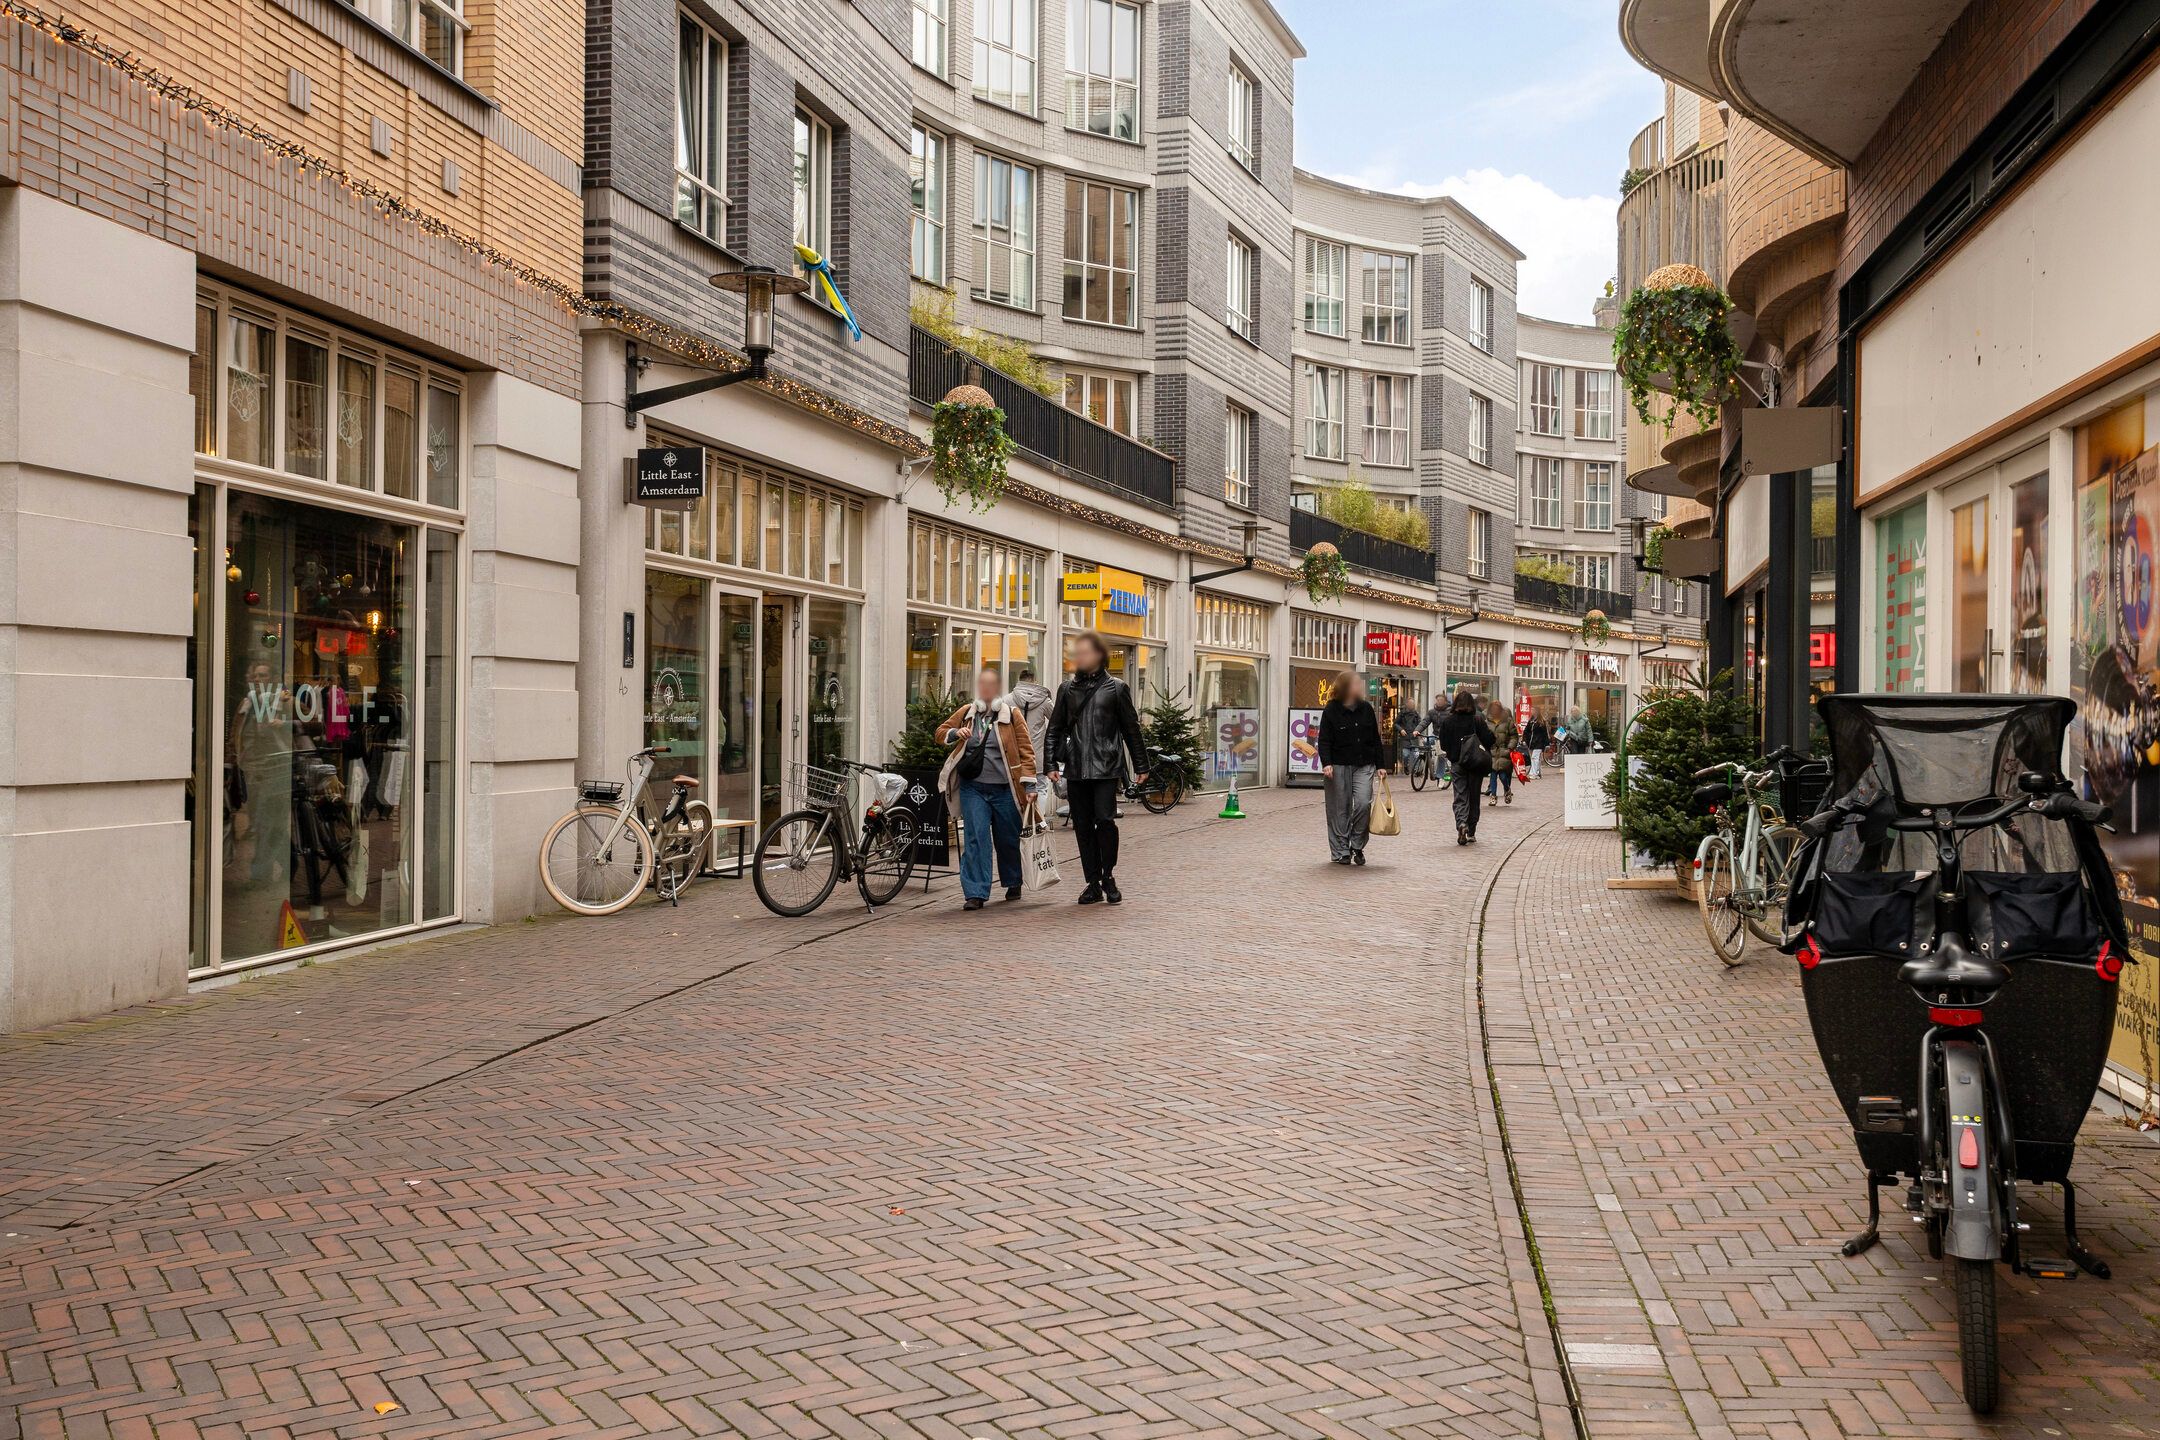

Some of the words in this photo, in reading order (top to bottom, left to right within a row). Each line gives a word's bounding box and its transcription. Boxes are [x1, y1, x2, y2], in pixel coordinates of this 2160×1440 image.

[641, 470, 668, 480] Little
[671, 470, 692, 479] East
[641, 485, 700, 496] Amsterdam
[1109, 588, 1148, 617] ZEEMAN
[1382, 632, 1420, 668] HEMA
[669, 711, 697, 723] Amsterdam
[1576, 761, 1605, 776] STAR
[896, 835, 944, 846] Amerdam
